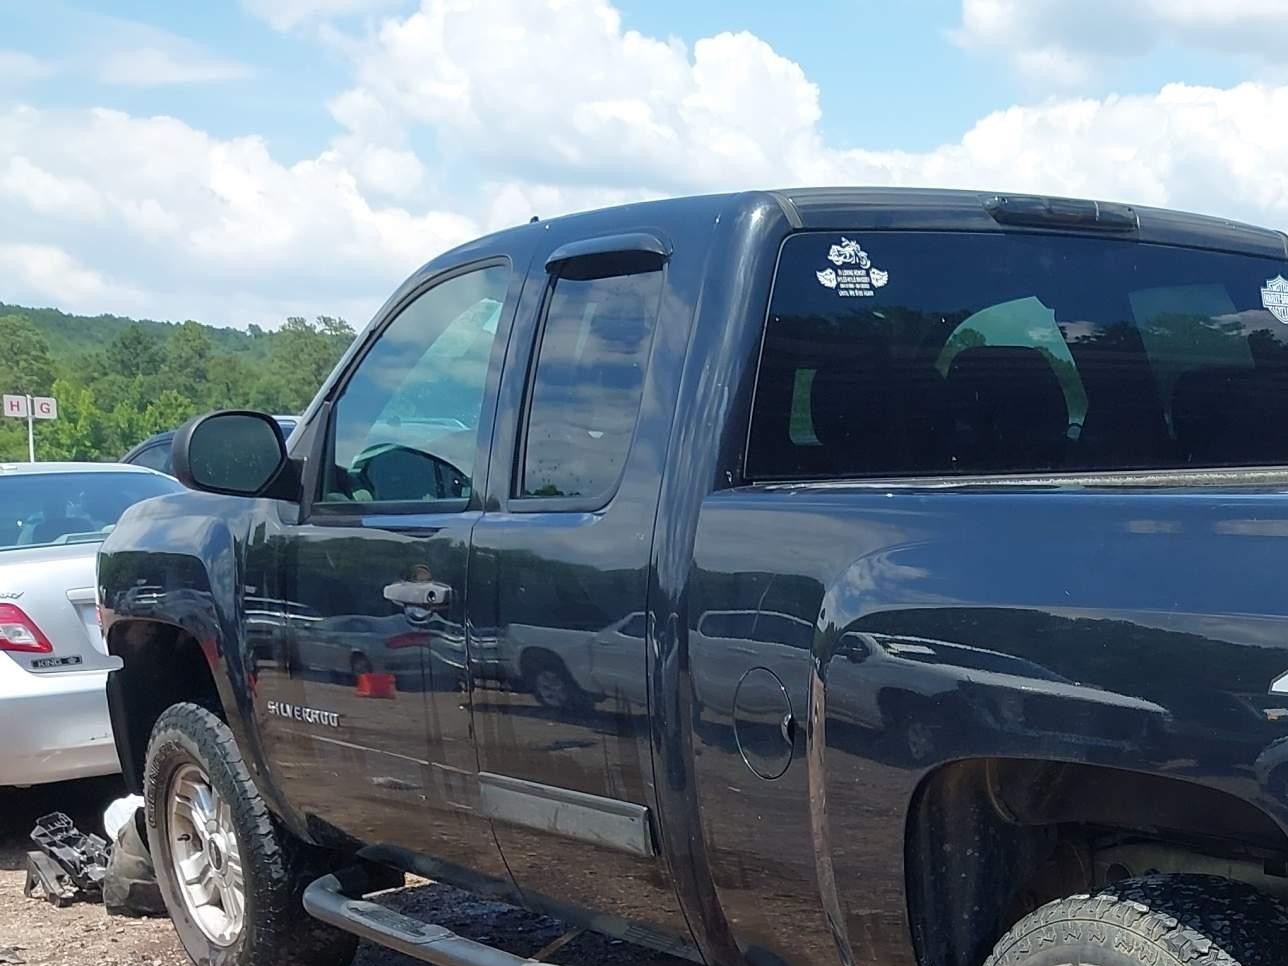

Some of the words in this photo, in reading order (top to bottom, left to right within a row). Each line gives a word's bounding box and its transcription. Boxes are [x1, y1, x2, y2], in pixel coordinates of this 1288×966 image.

[10, 401, 20, 411] H
[40, 402, 51, 413] G
[267, 701, 339, 727] SILVERADO
